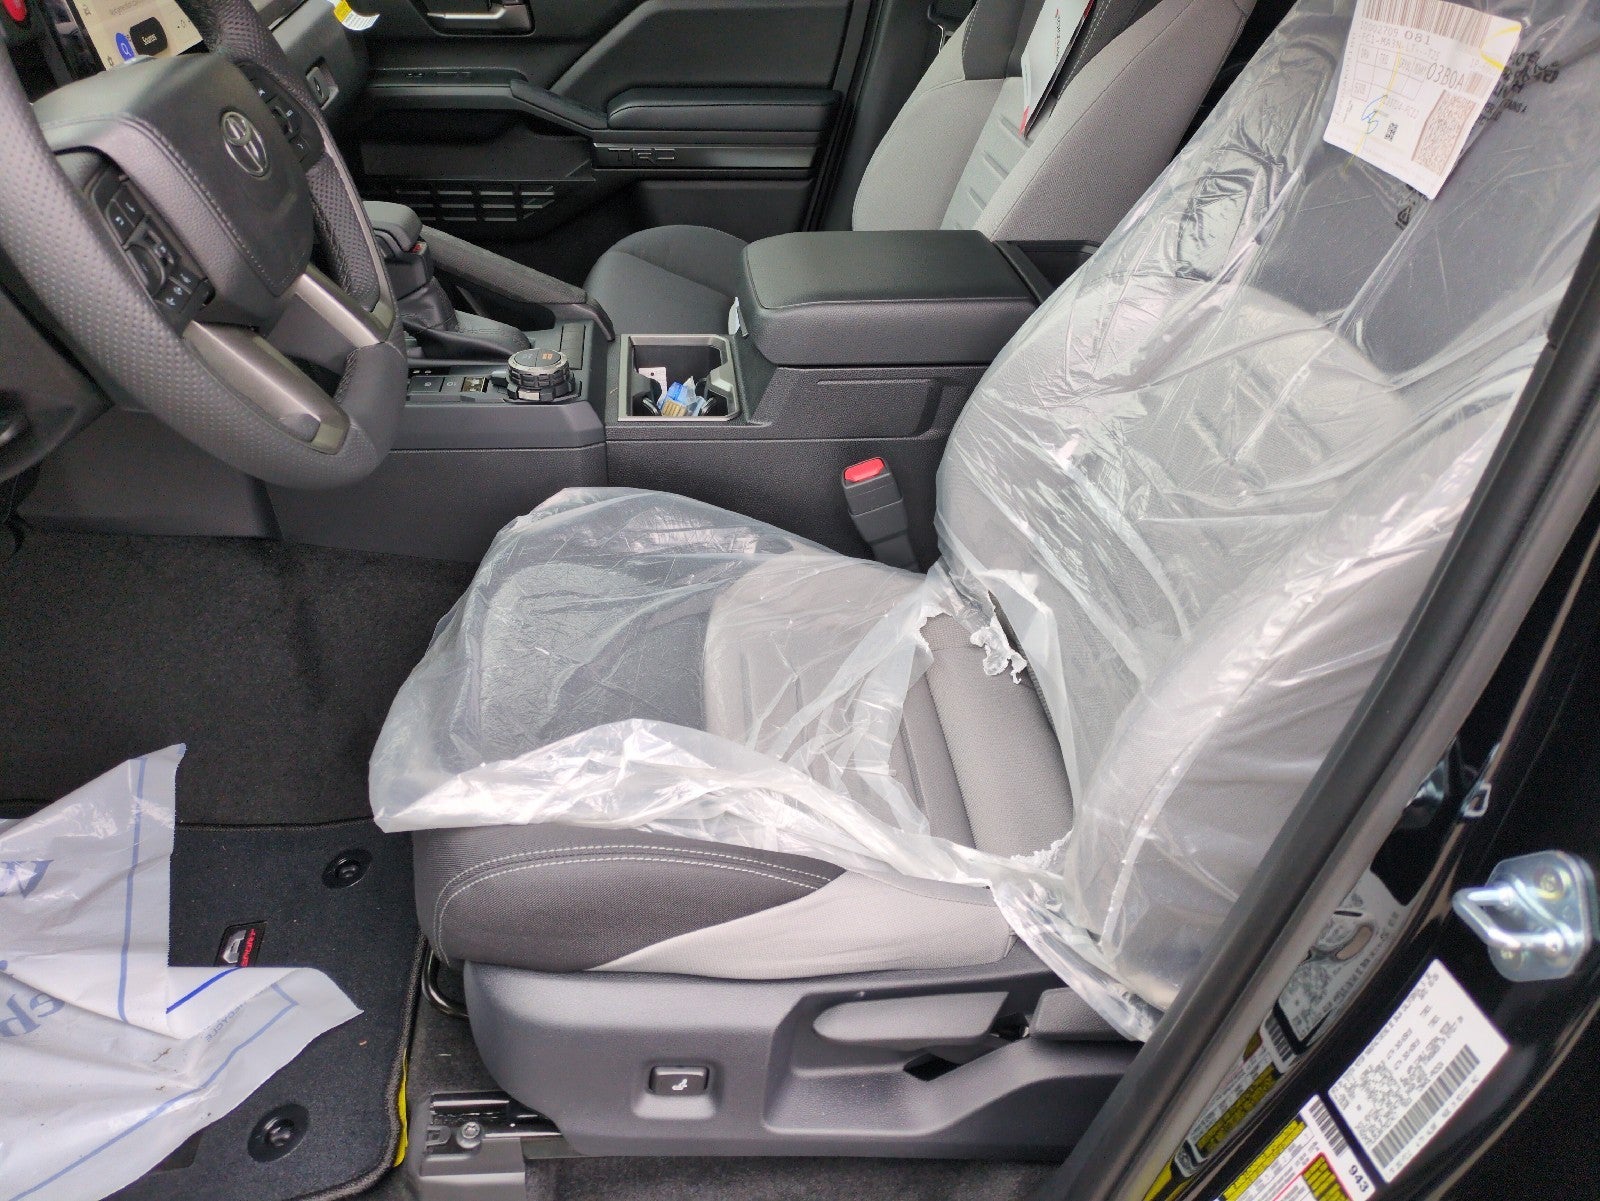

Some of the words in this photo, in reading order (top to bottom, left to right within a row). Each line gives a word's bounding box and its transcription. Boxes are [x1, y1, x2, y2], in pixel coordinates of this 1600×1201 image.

[1404, 30, 1431, 46] 081
[608, 147, 680, 165] TRD
[1348, 1164, 1370, 1193] 943
